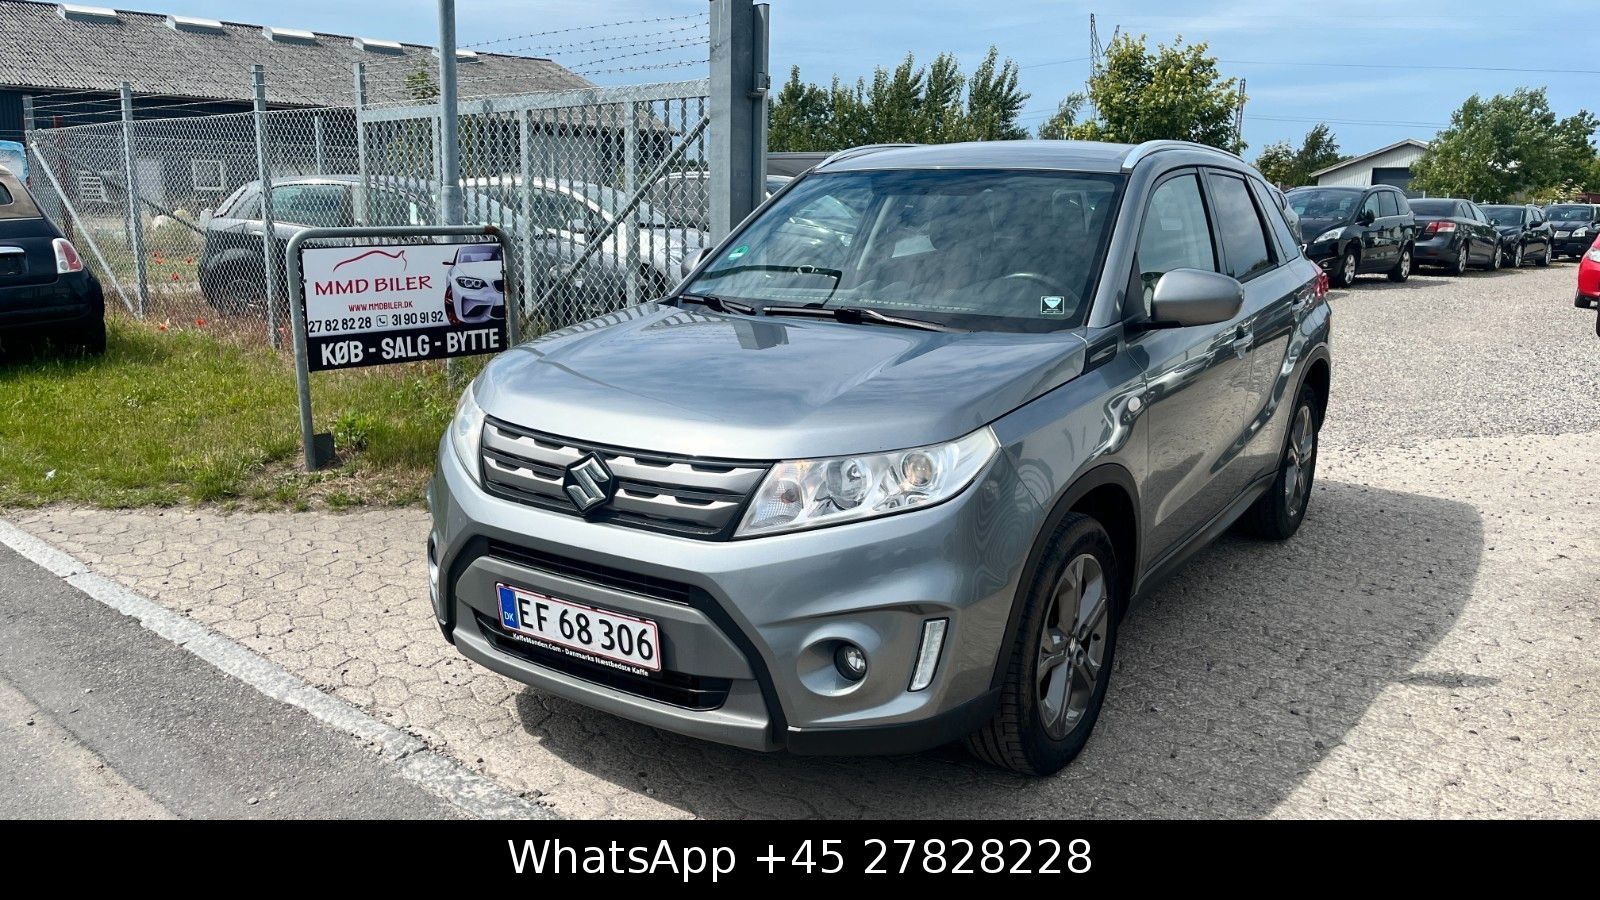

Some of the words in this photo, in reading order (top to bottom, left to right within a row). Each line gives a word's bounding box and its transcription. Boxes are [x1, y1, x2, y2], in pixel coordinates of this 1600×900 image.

[315, 278, 369, 295] MMD
[375, 275, 432, 292] BILER
[348, 301, 413, 312] WWW.MMDBILER.DK
[308, 321, 322, 333] 27
[325, 319, 339, 332] 82
[341, 318, 356, 330] 82
[358, 316, 372, 329] 28
[404, 313, 417, 325] 90
[431, 310, 443, 323] 92
[321, 340, 364, 366] KØB
[381, 335, 430, 360] SALG
[447, 328, 499, 353] BYTTE
[504, 610, 515, 623] DK
[517, 597, 549, 632] EF
[559, 608, 593, 645] 68
[598, 618, 654, 661] 306
[565, 648, 594, 663] Danmarks
[632, 666, 649, 677] Kaffe
